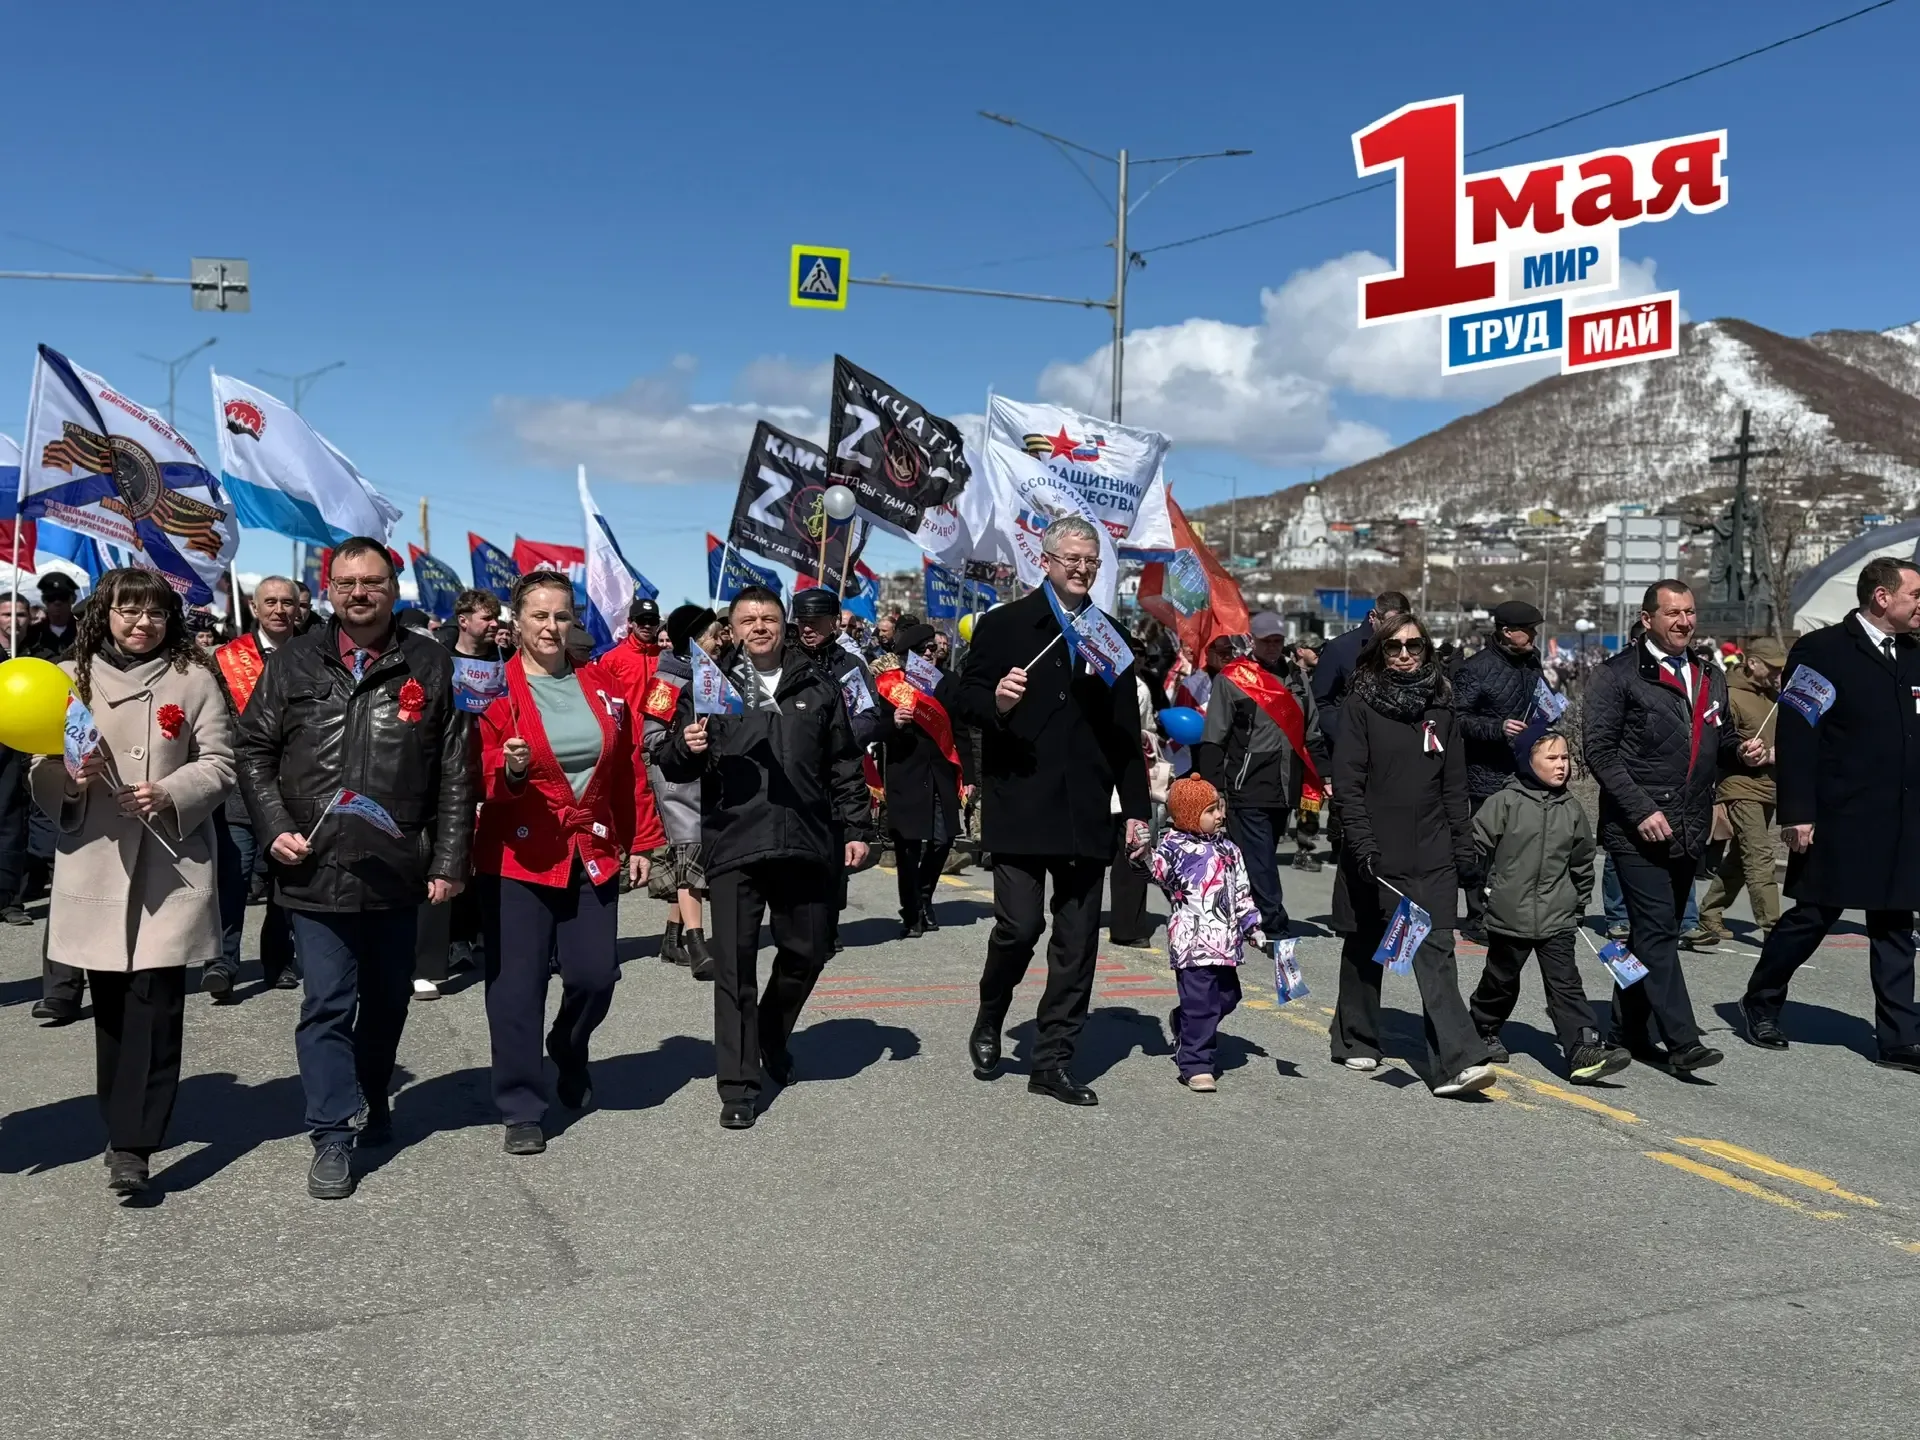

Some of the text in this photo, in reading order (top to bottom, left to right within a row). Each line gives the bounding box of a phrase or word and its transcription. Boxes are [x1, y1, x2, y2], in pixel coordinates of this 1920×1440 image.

[164, 487, 182, 503] ТАМ
[882, 493, 906, 511] ТАМ
[771, 542, 791, 557] ГДЕ
